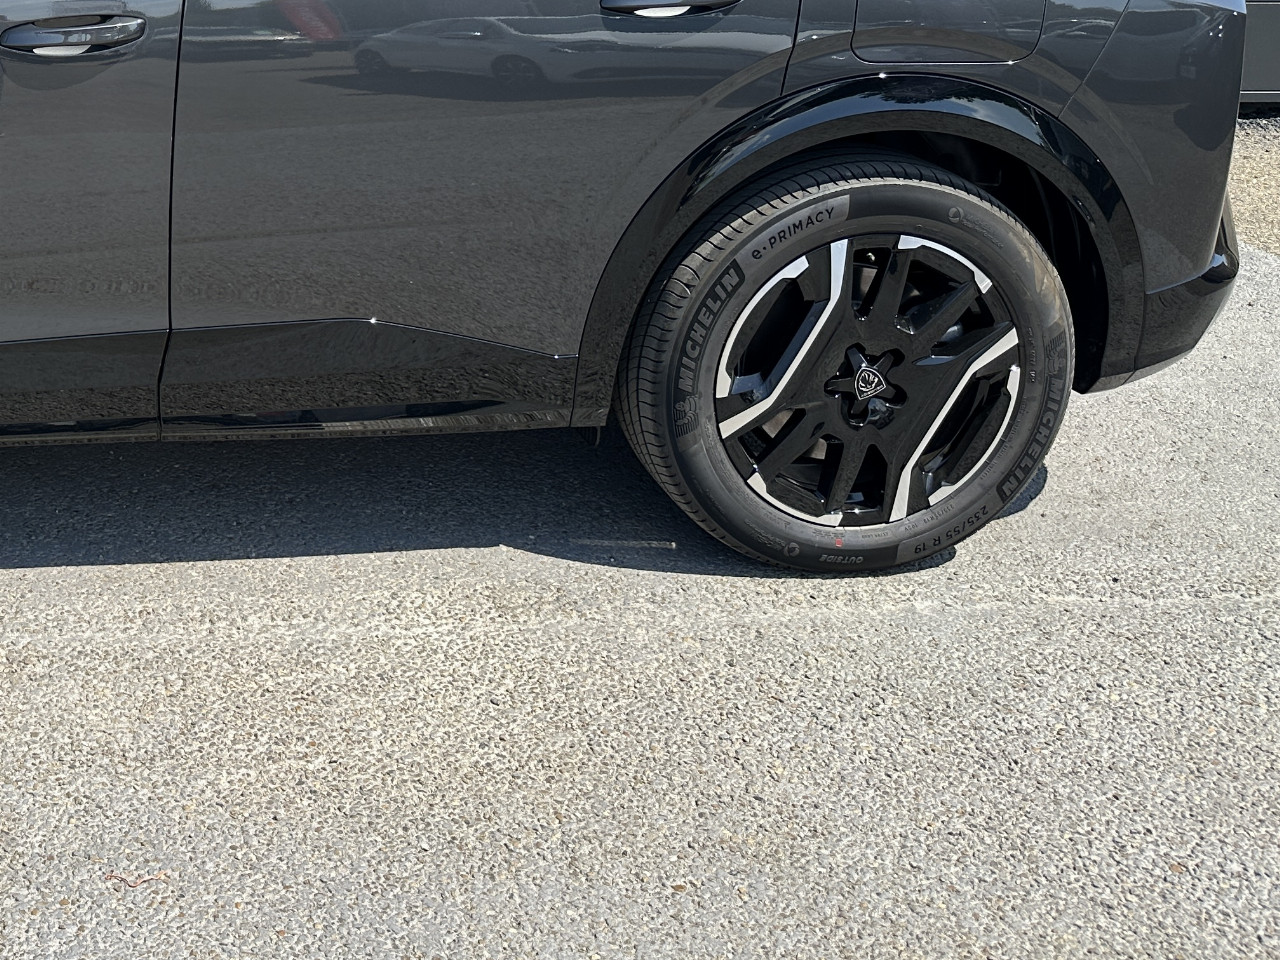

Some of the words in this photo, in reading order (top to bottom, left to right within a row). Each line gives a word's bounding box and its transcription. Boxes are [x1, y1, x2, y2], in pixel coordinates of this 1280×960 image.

[679, 268, 741, 393] MICHELIN
[1001, 378, 1065, 497] MICHELIN
[819, 554, 864, 564] OUTSIDE
